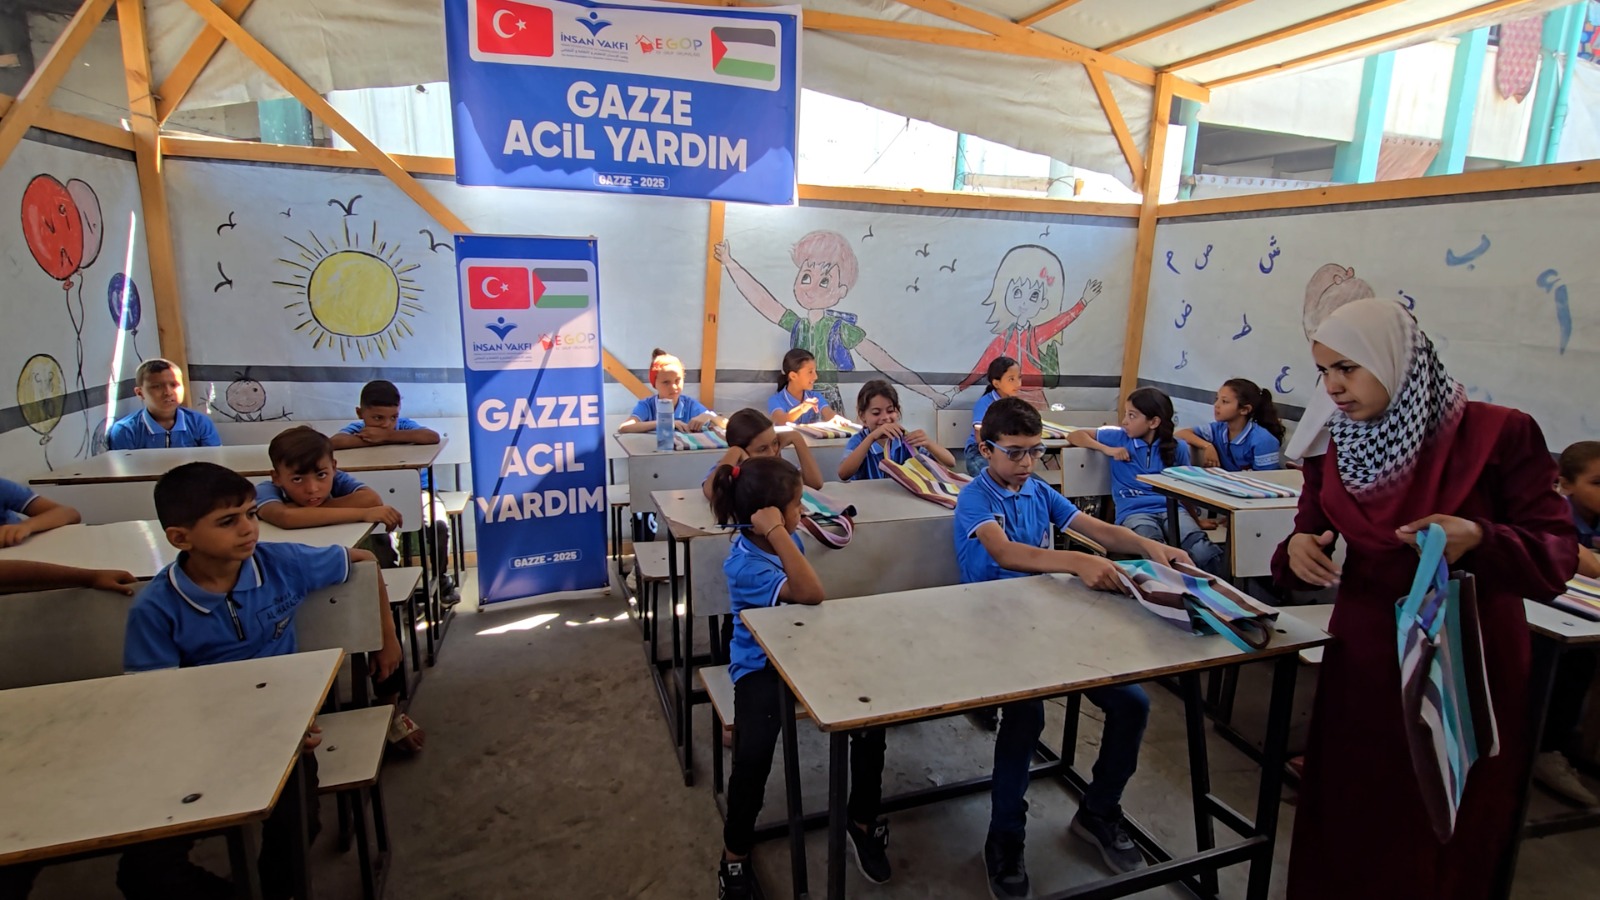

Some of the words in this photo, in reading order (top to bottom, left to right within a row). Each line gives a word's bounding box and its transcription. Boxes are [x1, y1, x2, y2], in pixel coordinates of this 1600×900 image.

[597, 39, 629, 51] VAKFI
[566, 80, 692, 126] GAZZE
[604, 126, 748, 172] YARDIM
[597, 175, 632, 188] GAZZE
[640, 177, 665, 188] 2025
[1195, 244, 1213, 270] ص
[1259, 235, 1281, 274] ش
[1445, 234, 1491, 271] ب
[1175, 299, 1193, 329] ض
[1232, 313, 1252, 341] ط
[1536, 269, 1572, 356] أ
[505, 342, 532, 351] VAKFI
[1275, 366, 1295, 394] ع
[477, 395, 600, 432] GAZZE
[476, 486, 605, 524] YARDIM
[514, 555, 546, 568] GAZZE
[553, 551, 577, 562] 2025
